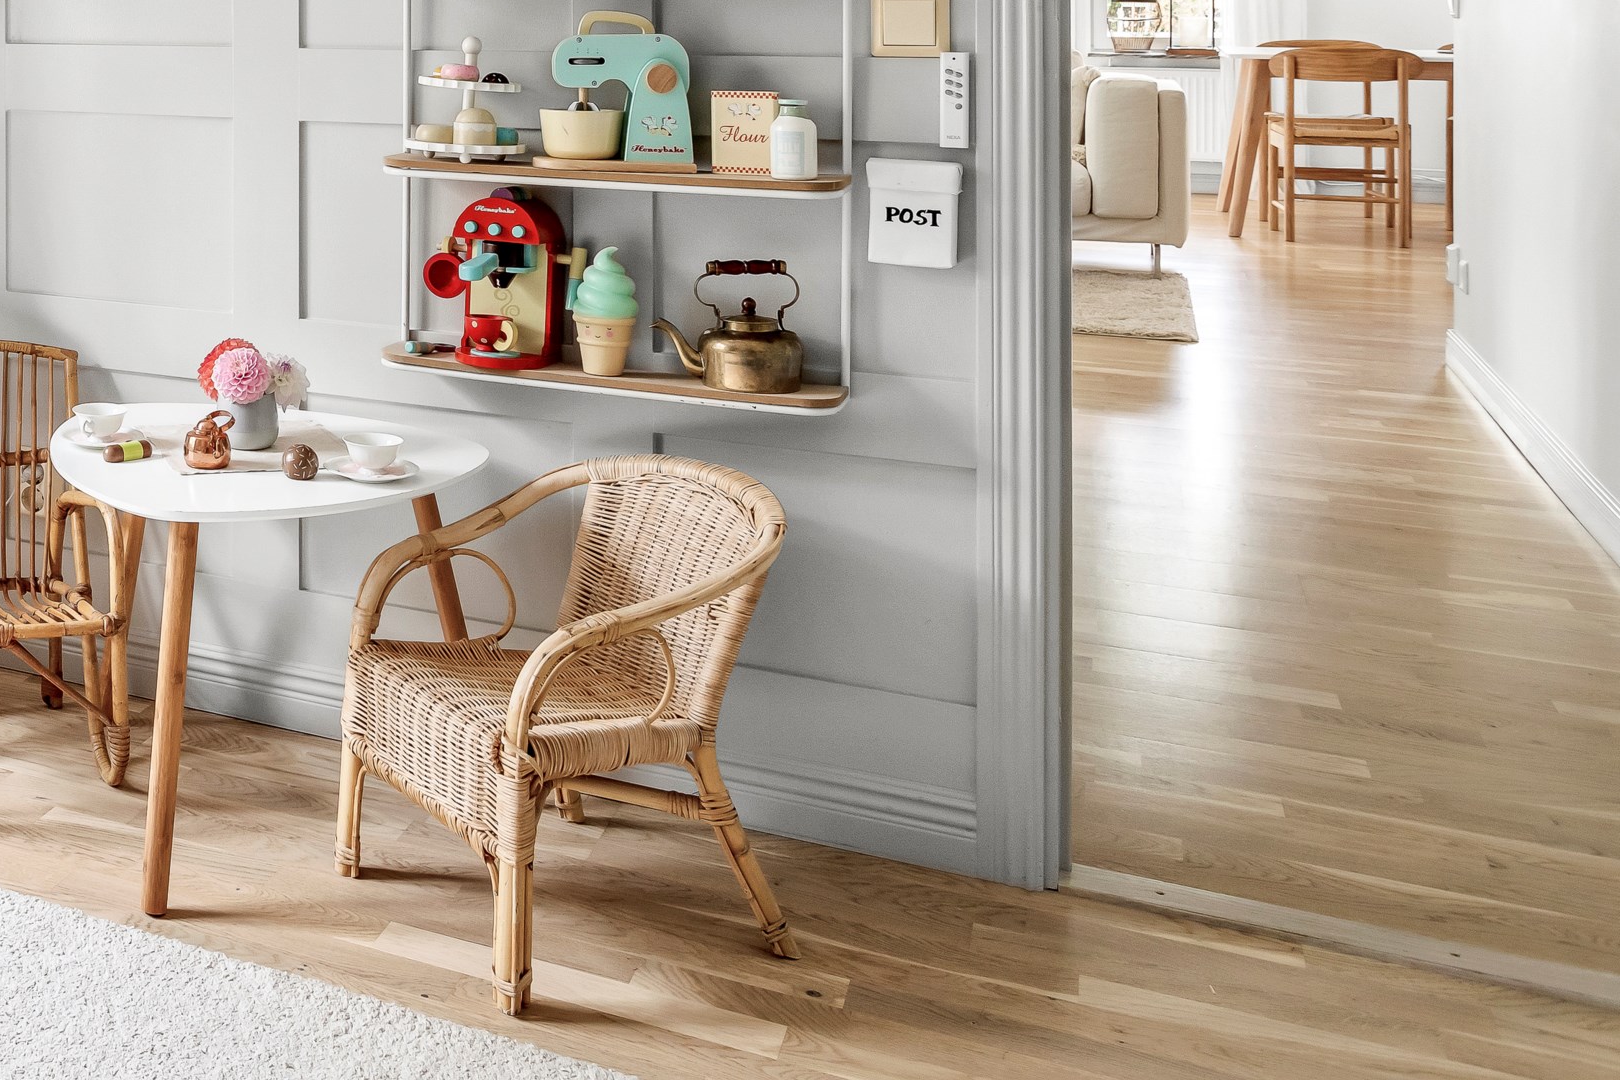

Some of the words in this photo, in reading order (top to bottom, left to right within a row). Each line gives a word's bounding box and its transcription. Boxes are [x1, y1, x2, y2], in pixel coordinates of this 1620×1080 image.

[720, 125, 770, 143] Flour
[631, 145, 684, 154] Honeybake
[474, 205, 515, 214] Honeybake
[885, 206, 942, 227] POST
